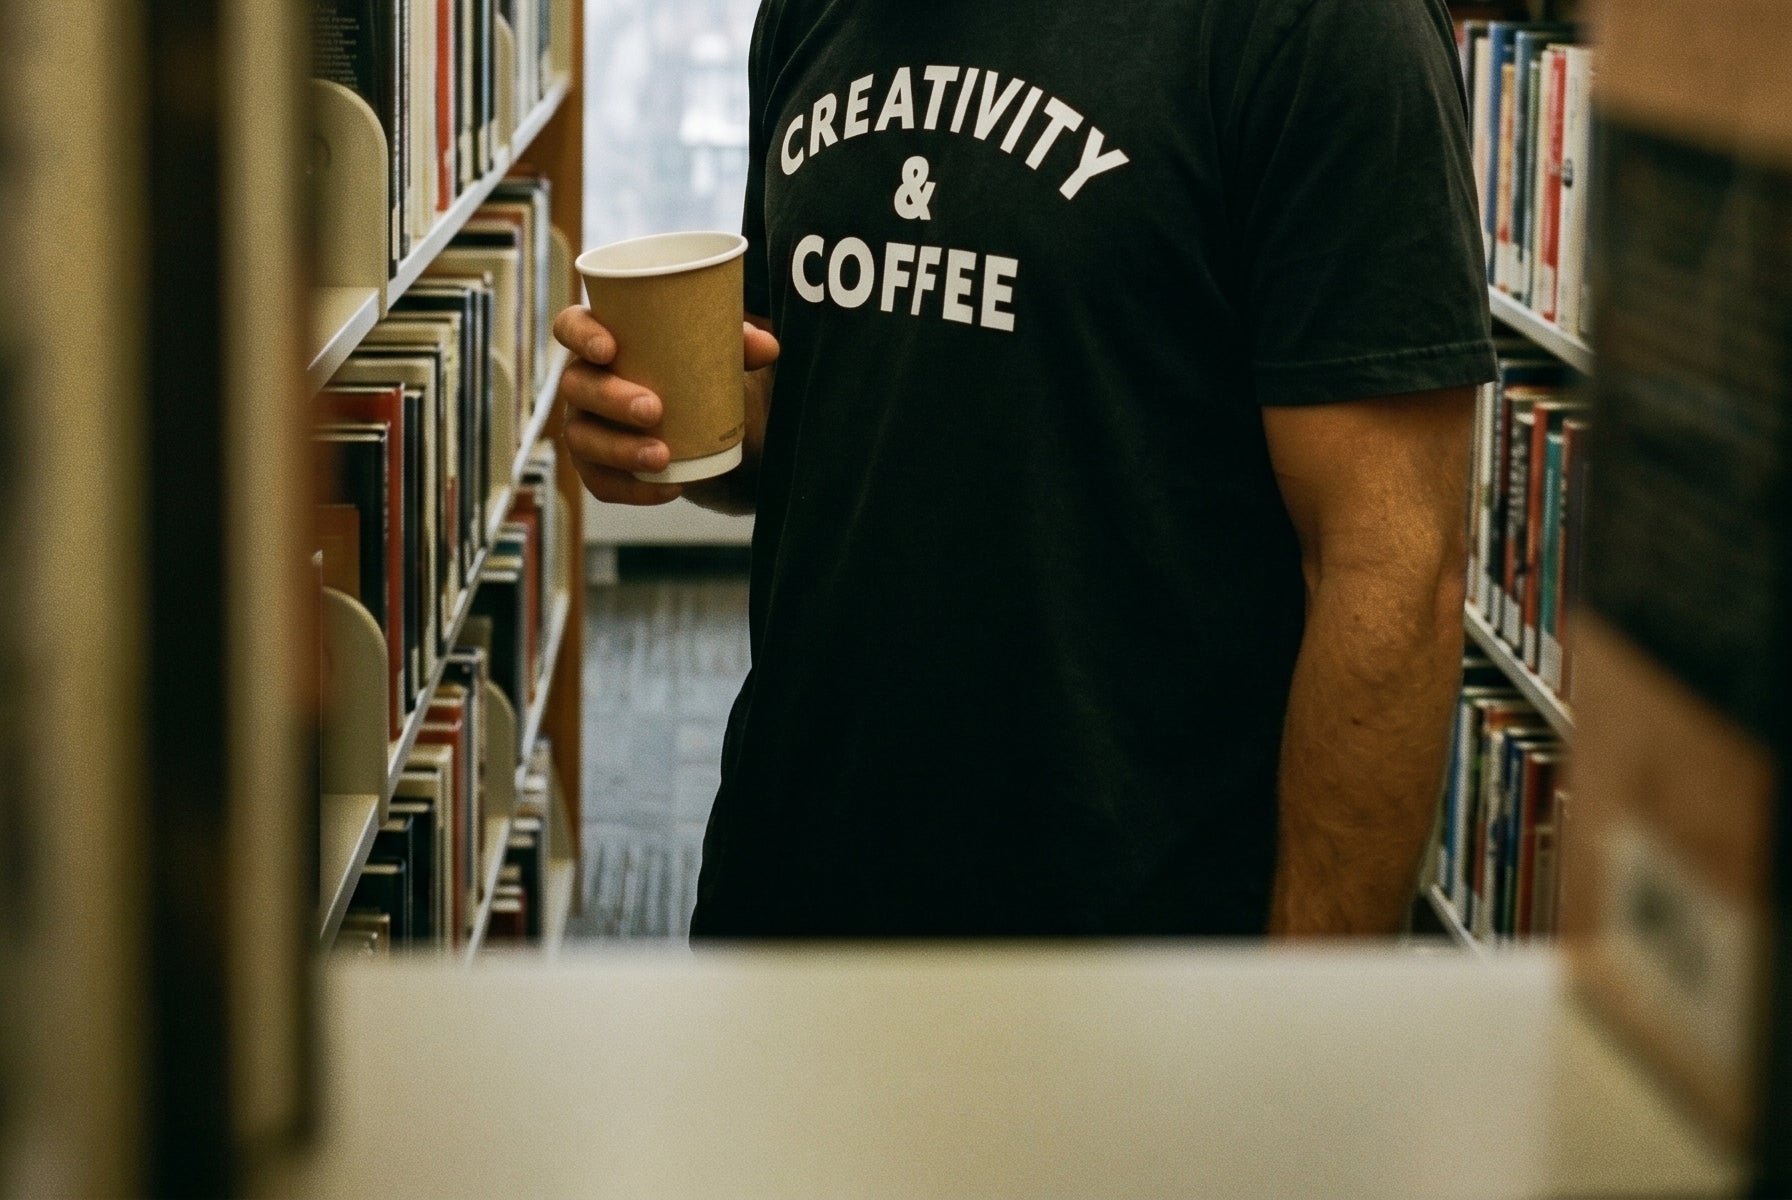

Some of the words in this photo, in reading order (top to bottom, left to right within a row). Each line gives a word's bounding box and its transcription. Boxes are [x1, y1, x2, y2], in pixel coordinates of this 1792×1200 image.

[780, 65, 1130, 201] CREATIVITY
[893, 155, 936, 221] &
[791, 234, 1019, 332] COFFEE
